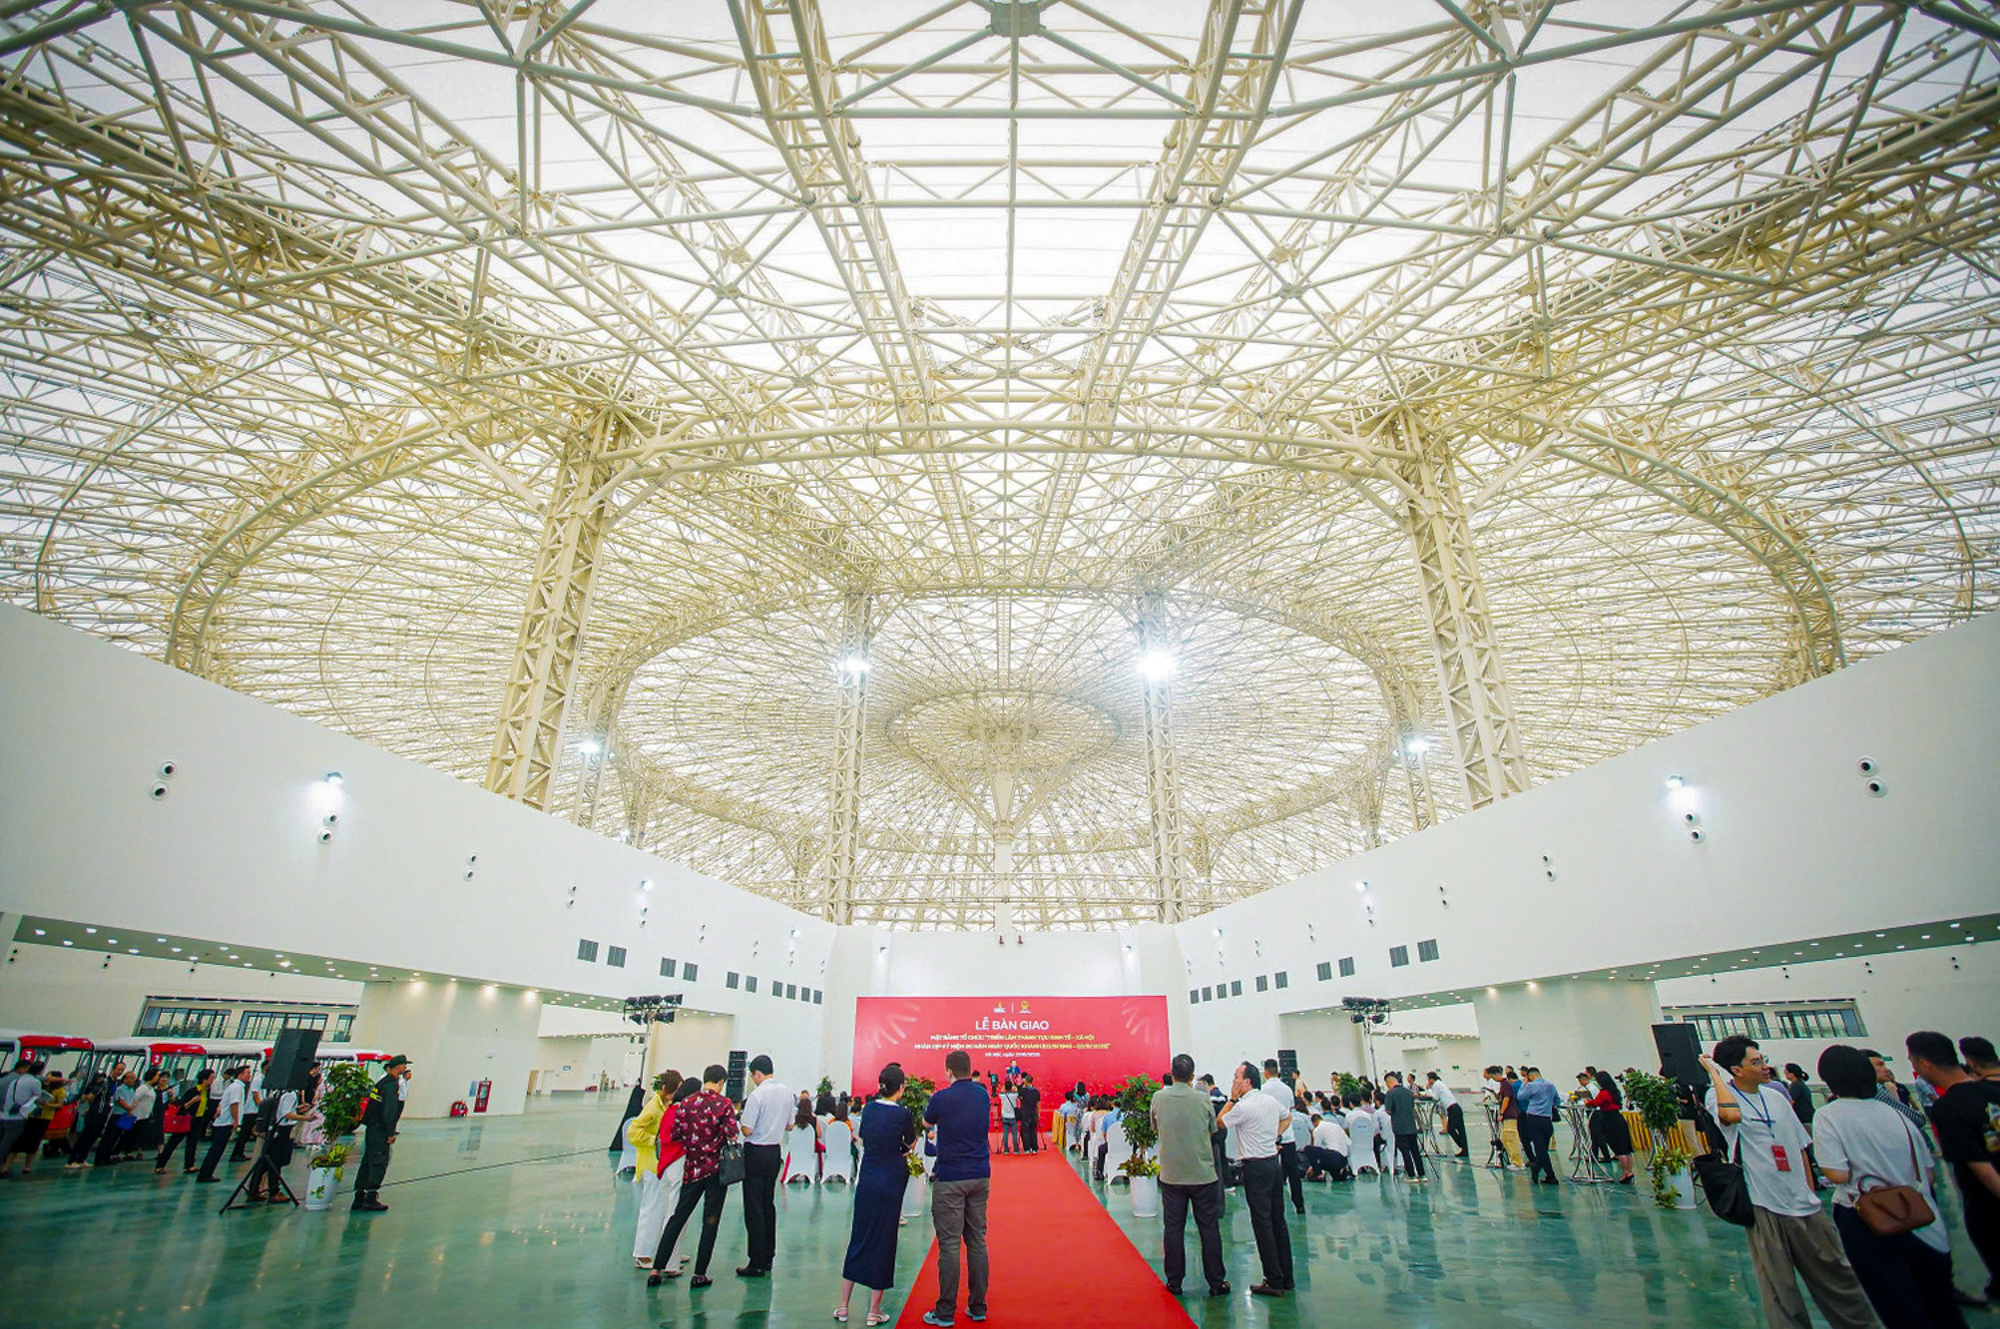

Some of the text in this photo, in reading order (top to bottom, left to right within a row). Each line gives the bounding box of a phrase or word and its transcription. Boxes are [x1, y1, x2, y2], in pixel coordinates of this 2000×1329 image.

[975, 1016, 1049, 1030] LỄ BÀN GIAO
[25, 1051, 32, 1060] 3
[154, 1055, 160, 1063] 2
